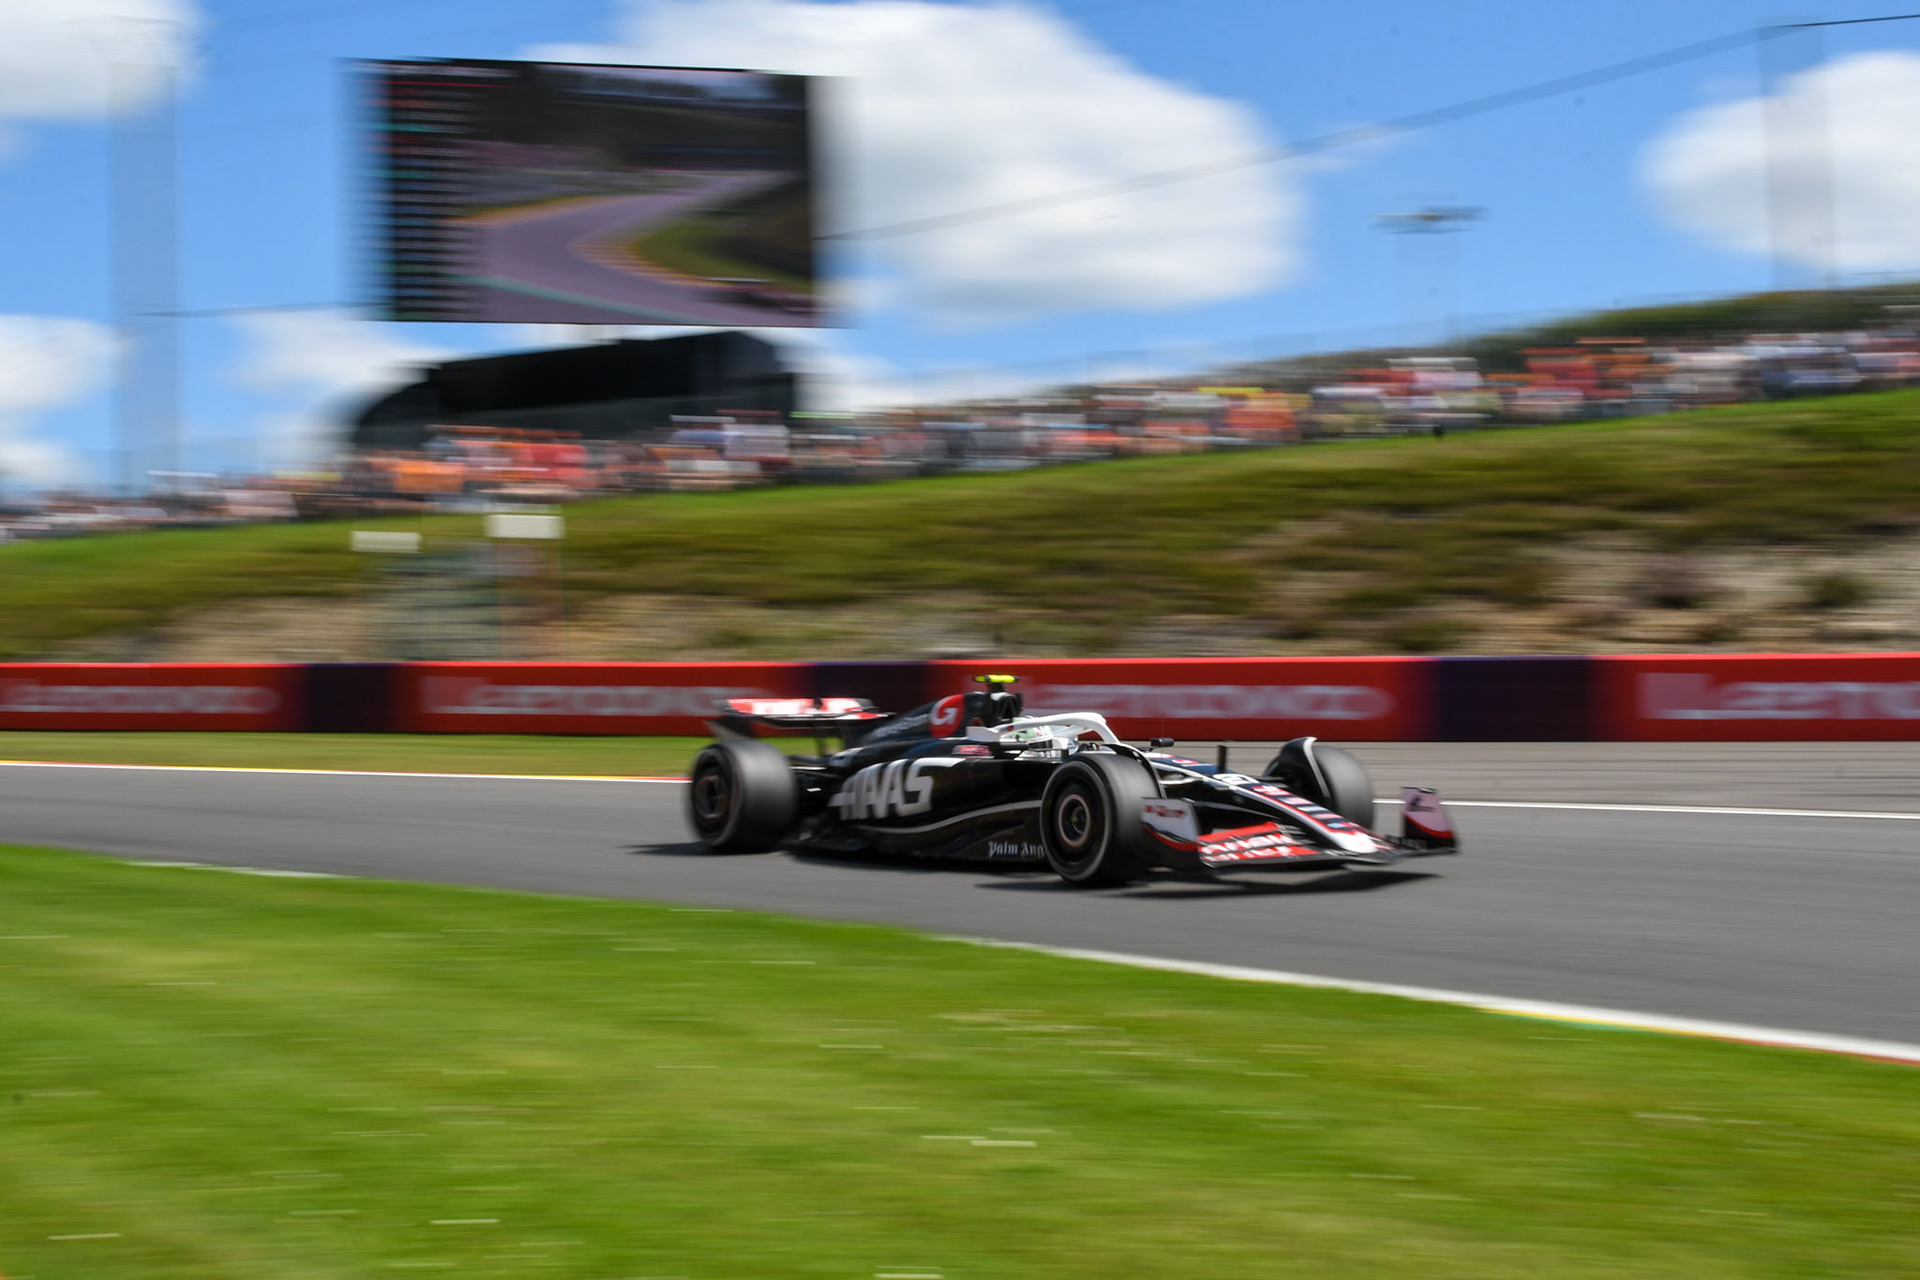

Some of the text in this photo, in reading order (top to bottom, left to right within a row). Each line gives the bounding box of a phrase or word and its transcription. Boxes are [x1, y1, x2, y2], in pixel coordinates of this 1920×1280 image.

[827, 757, 966, 821] HAAS
[988, 841, 1045, 860] Palm Ang
